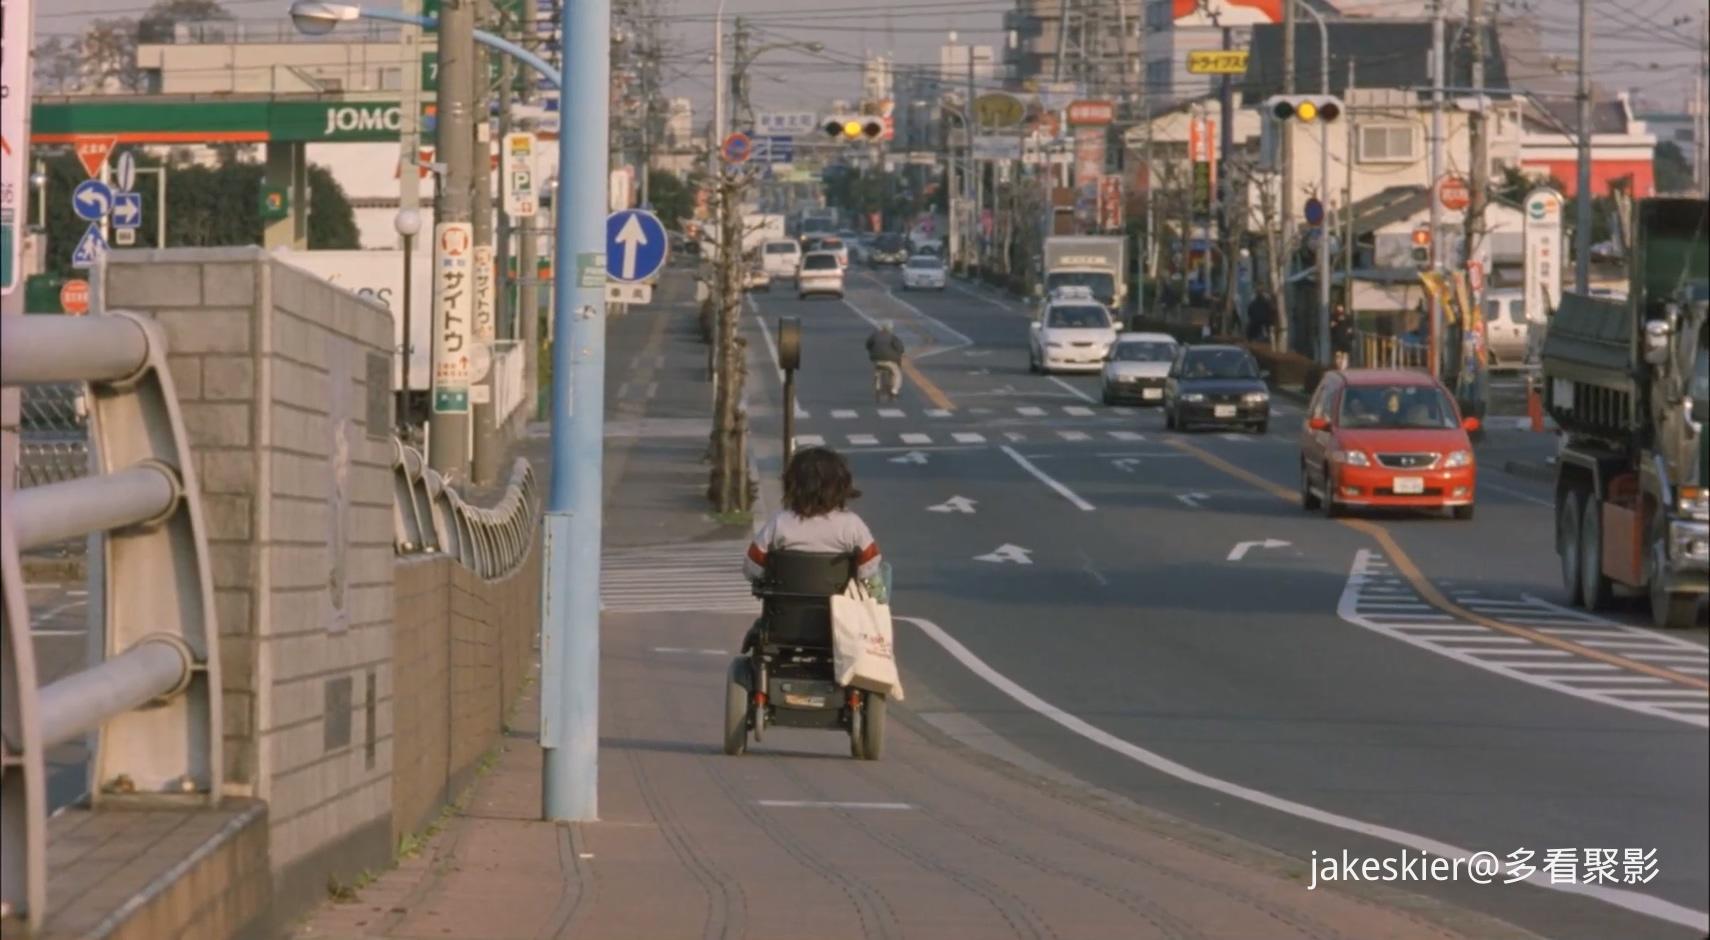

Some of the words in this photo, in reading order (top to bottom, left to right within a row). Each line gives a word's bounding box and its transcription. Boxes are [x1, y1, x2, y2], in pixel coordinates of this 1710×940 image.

[443, 271, 465, 352] サイトウ
[477, 276, 490, 325] サイトウ
